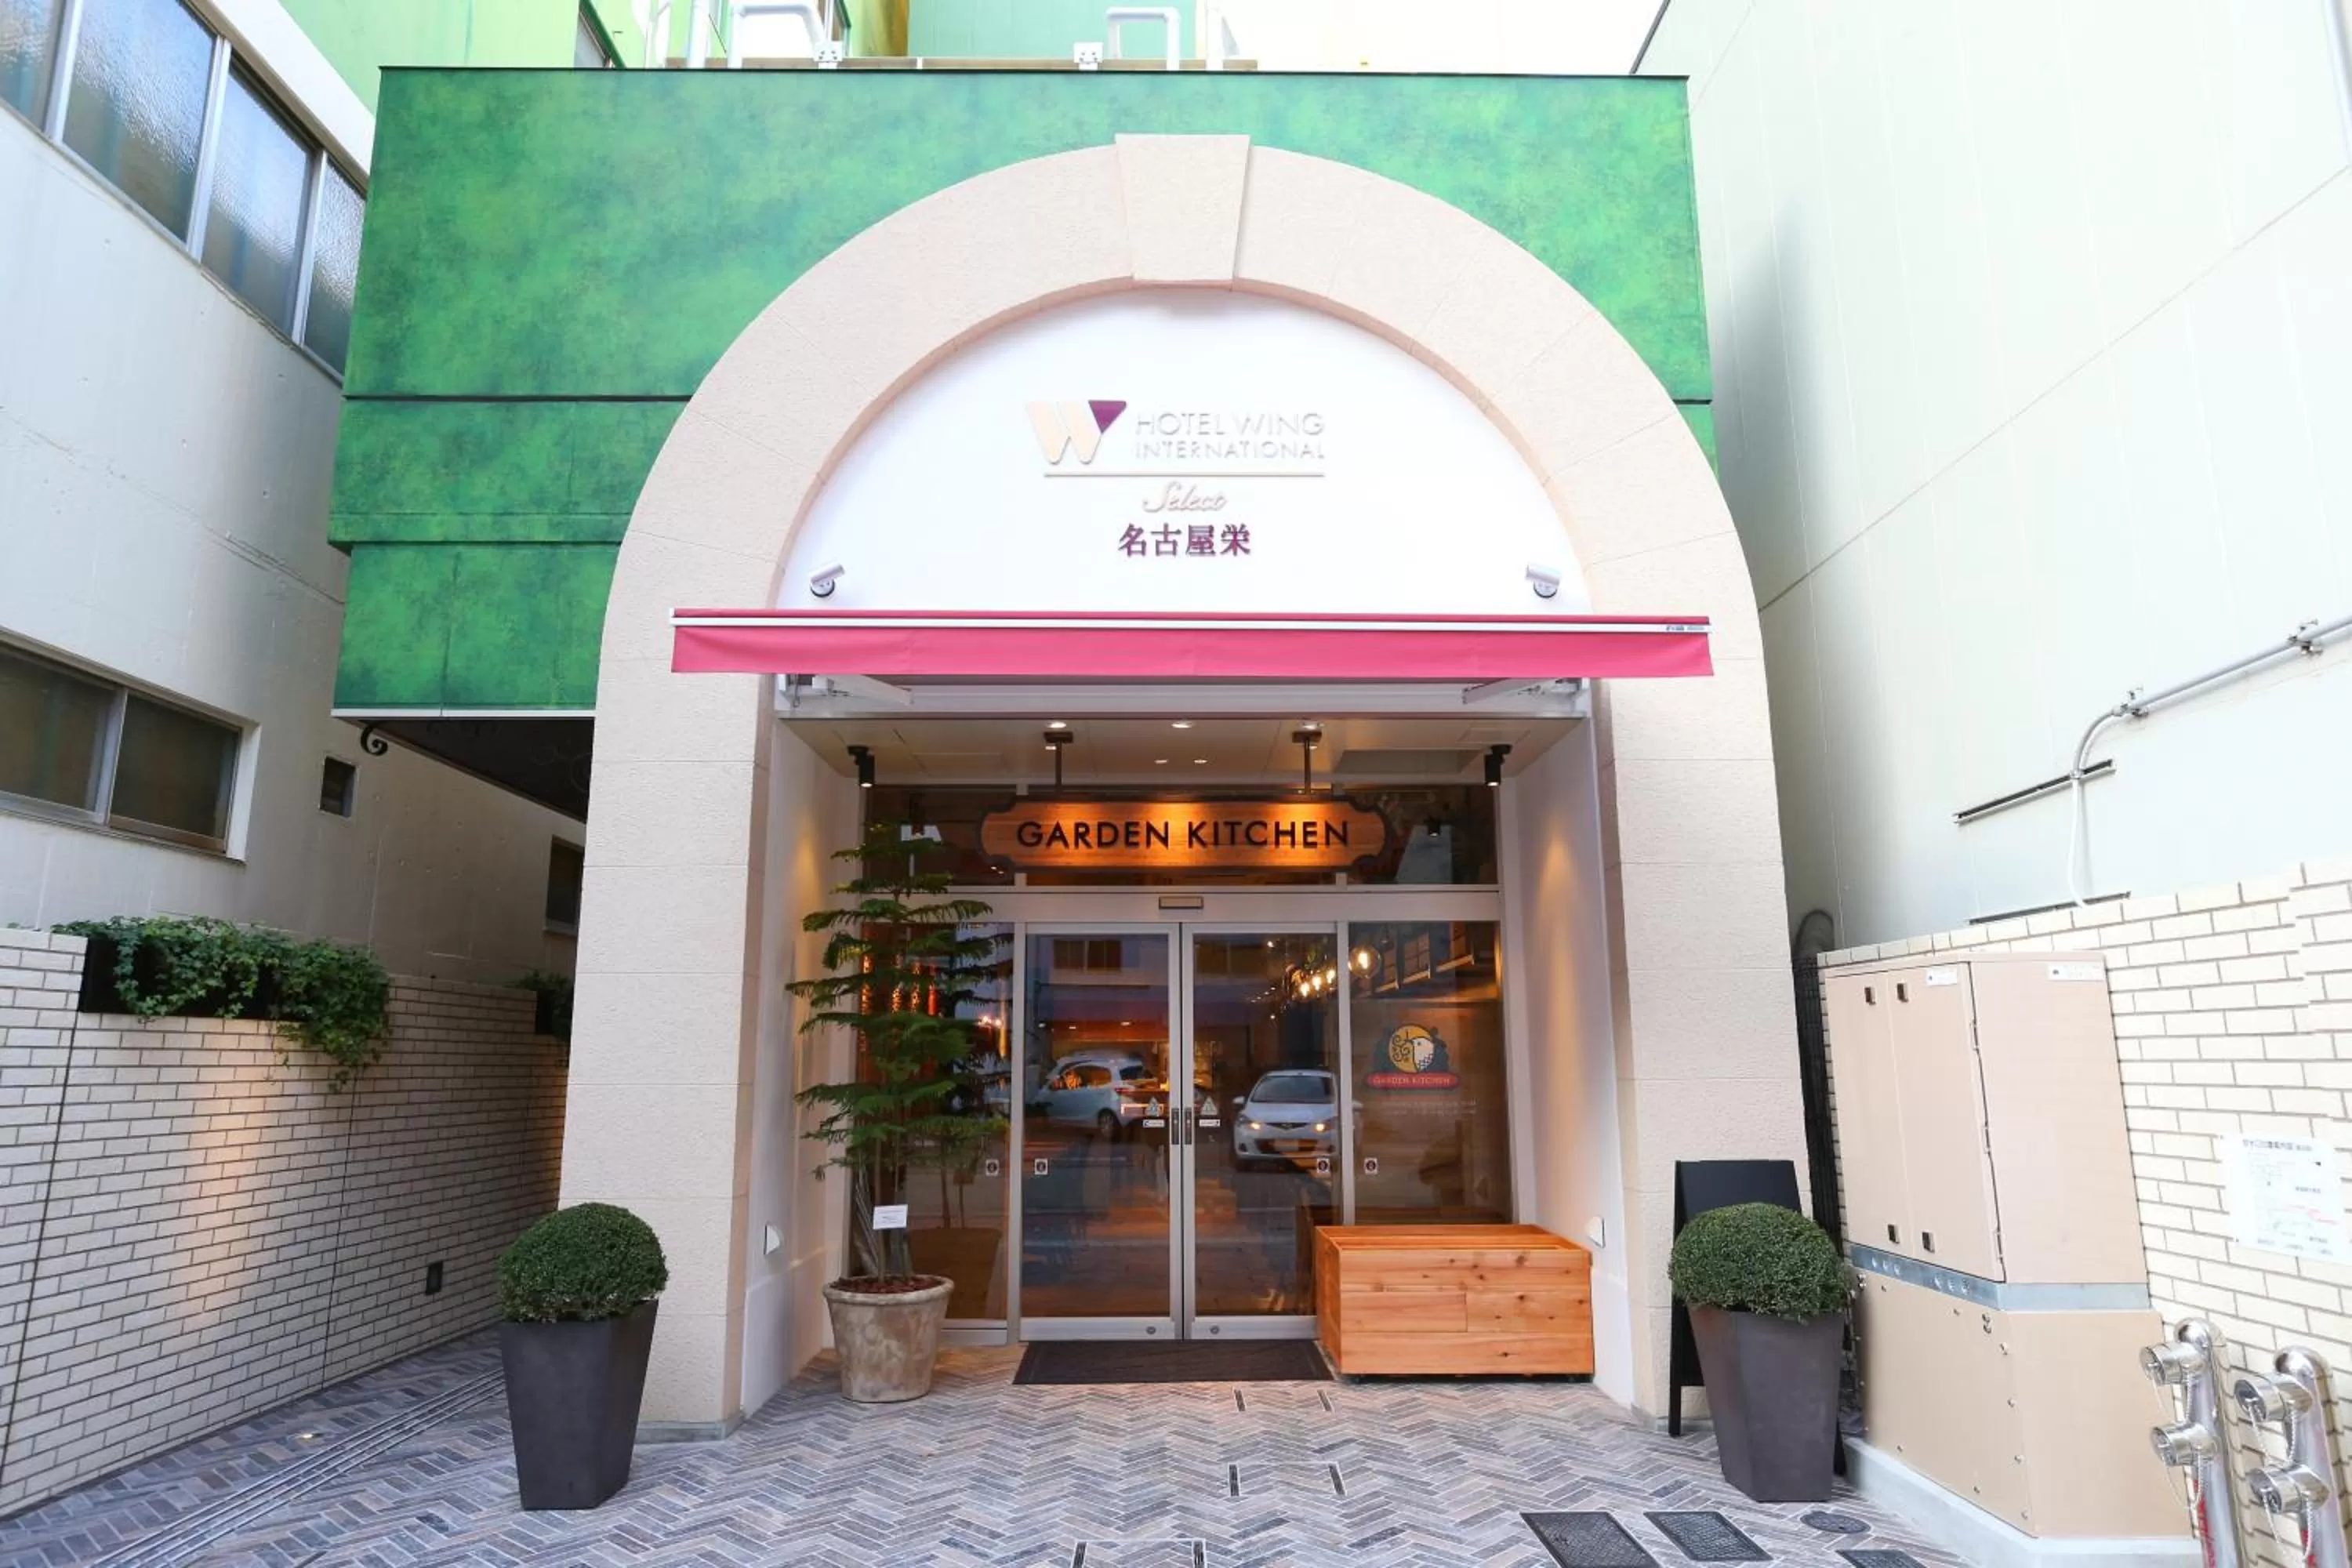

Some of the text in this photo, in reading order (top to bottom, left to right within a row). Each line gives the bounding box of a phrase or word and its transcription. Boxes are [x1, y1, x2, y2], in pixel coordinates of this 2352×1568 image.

[1136, 412, 1326, 436] HOTEL WING
[1136, 441, 1325, 459] INTERNATIONAL
[1142, 481, 1227, 514] Select
[1118, 523, 1251, 557] 名古屋栄
[1018, 821, 1348, 849] GARDEN KITCHEN
